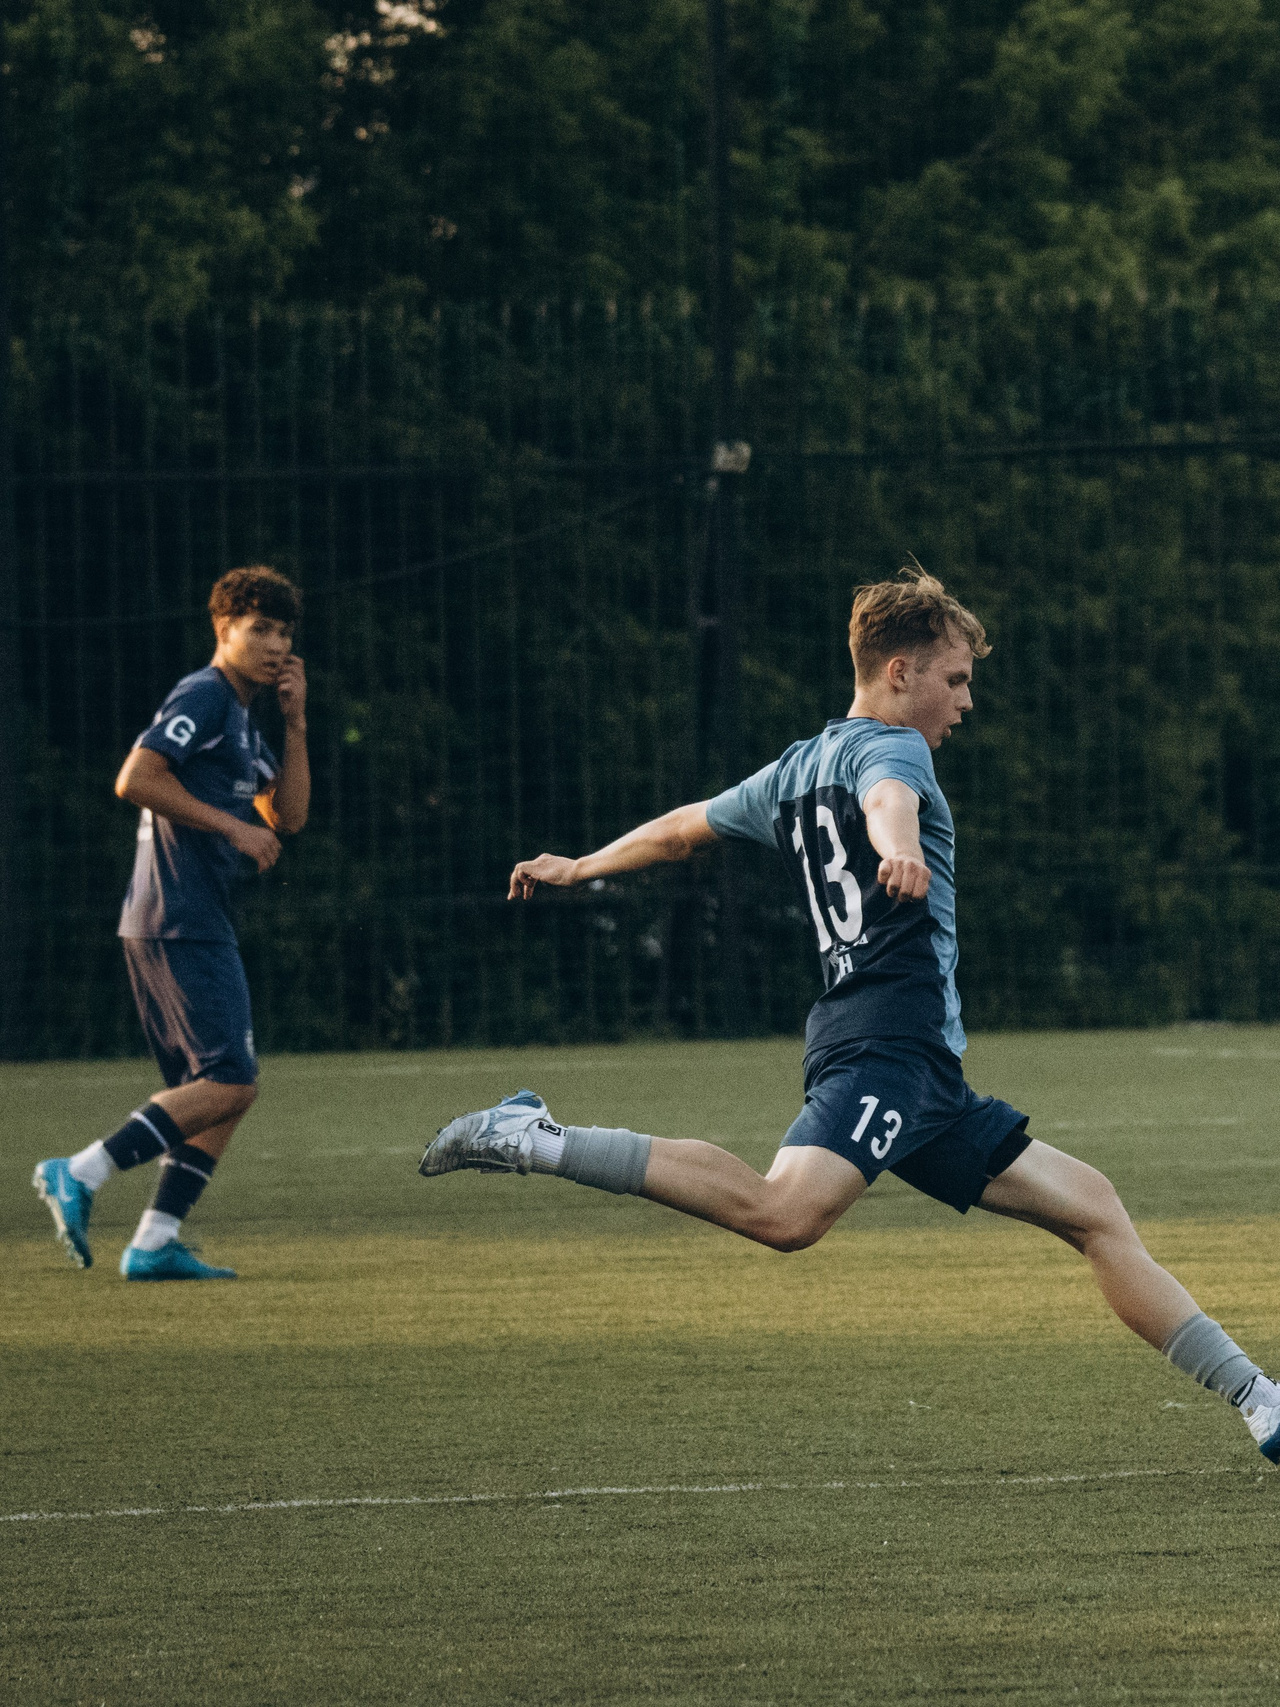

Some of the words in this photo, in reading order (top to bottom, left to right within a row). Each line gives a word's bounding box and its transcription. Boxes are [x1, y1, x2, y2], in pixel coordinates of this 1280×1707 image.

[165, 714, 196, 747] G
[791, 805, 864, 952] 13
[851, 1095, 902, 1160] 13
